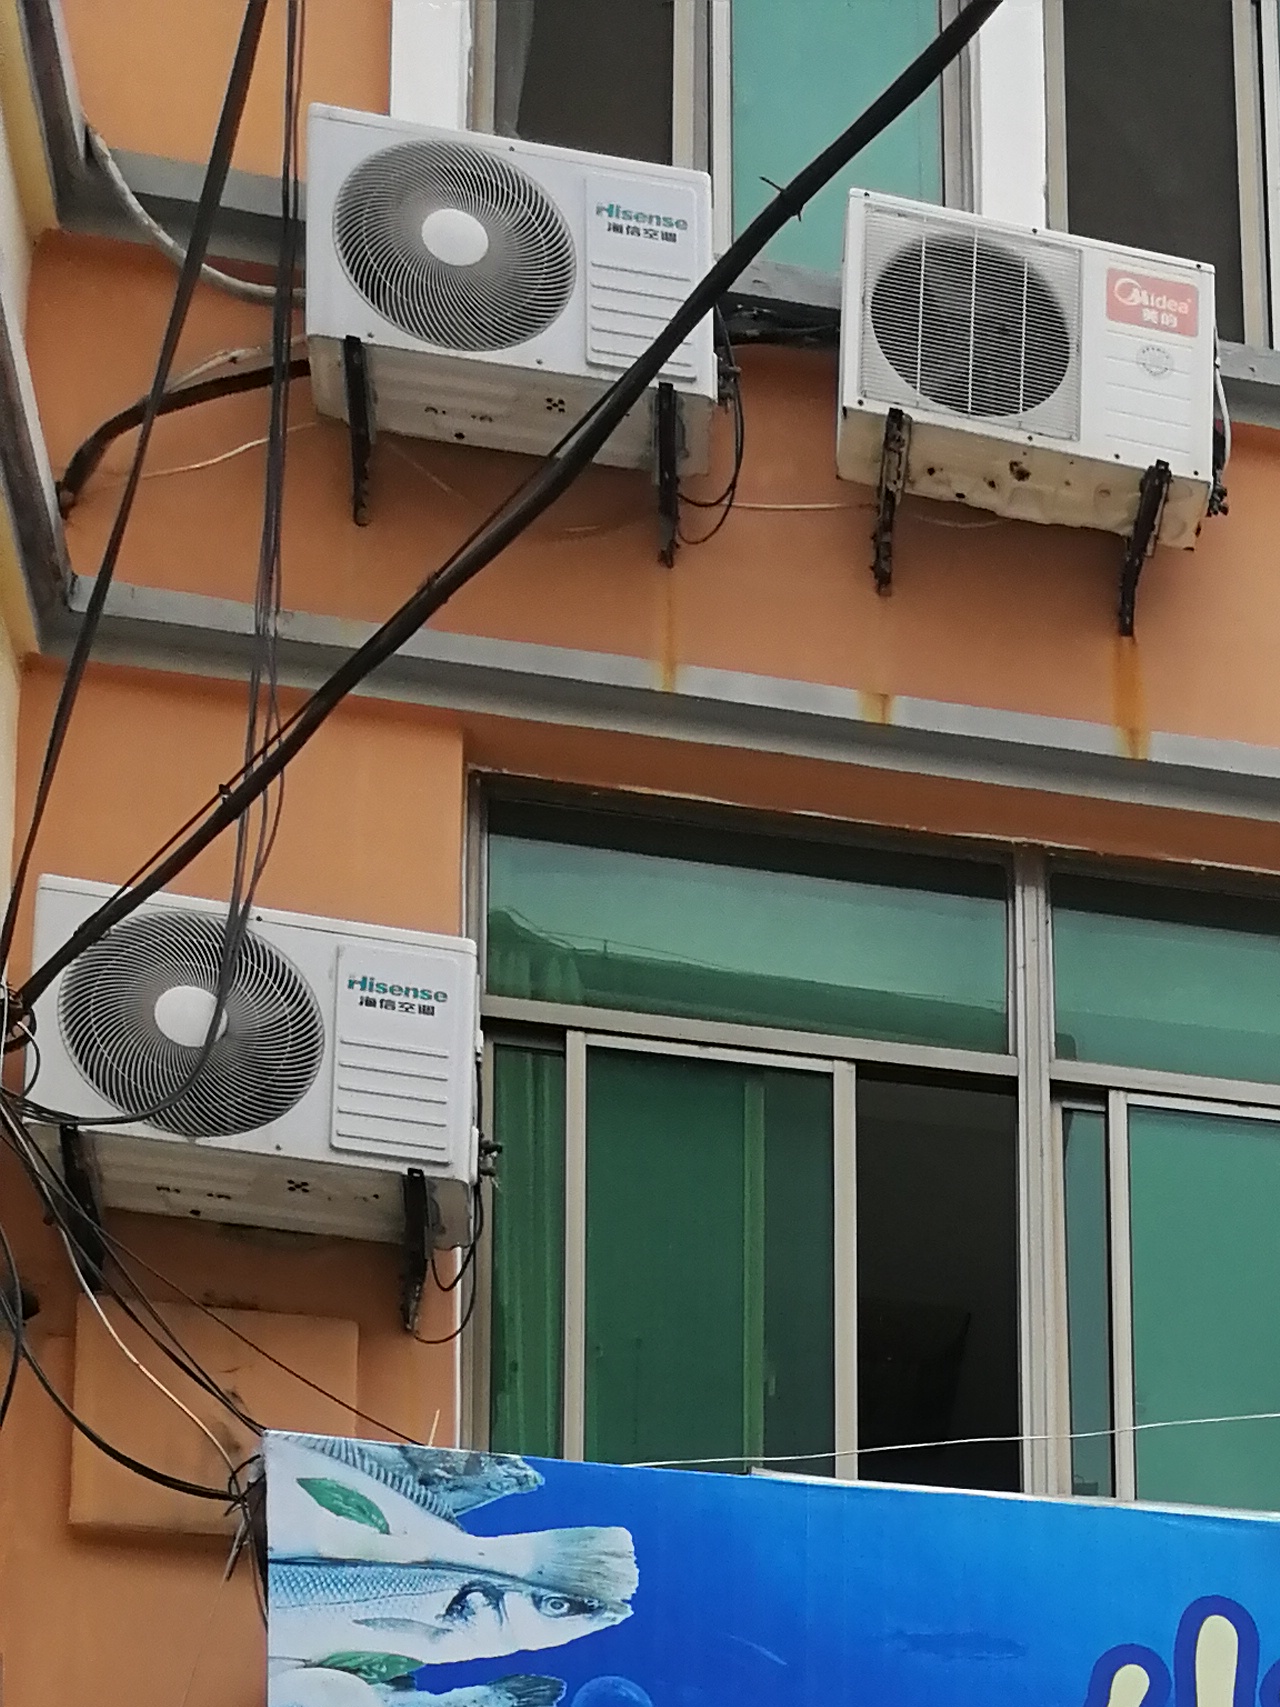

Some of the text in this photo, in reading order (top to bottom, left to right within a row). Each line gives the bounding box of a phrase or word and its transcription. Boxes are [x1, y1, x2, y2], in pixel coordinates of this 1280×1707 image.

[596, 203, 689, 231] Hisense
[1113, 277, 1189, 315] Midea
[1141, 307, 1178, 328] 美的
[347, 975, 448, 1003] Hisense
[359, 995, 435, 1016] 海信空调
